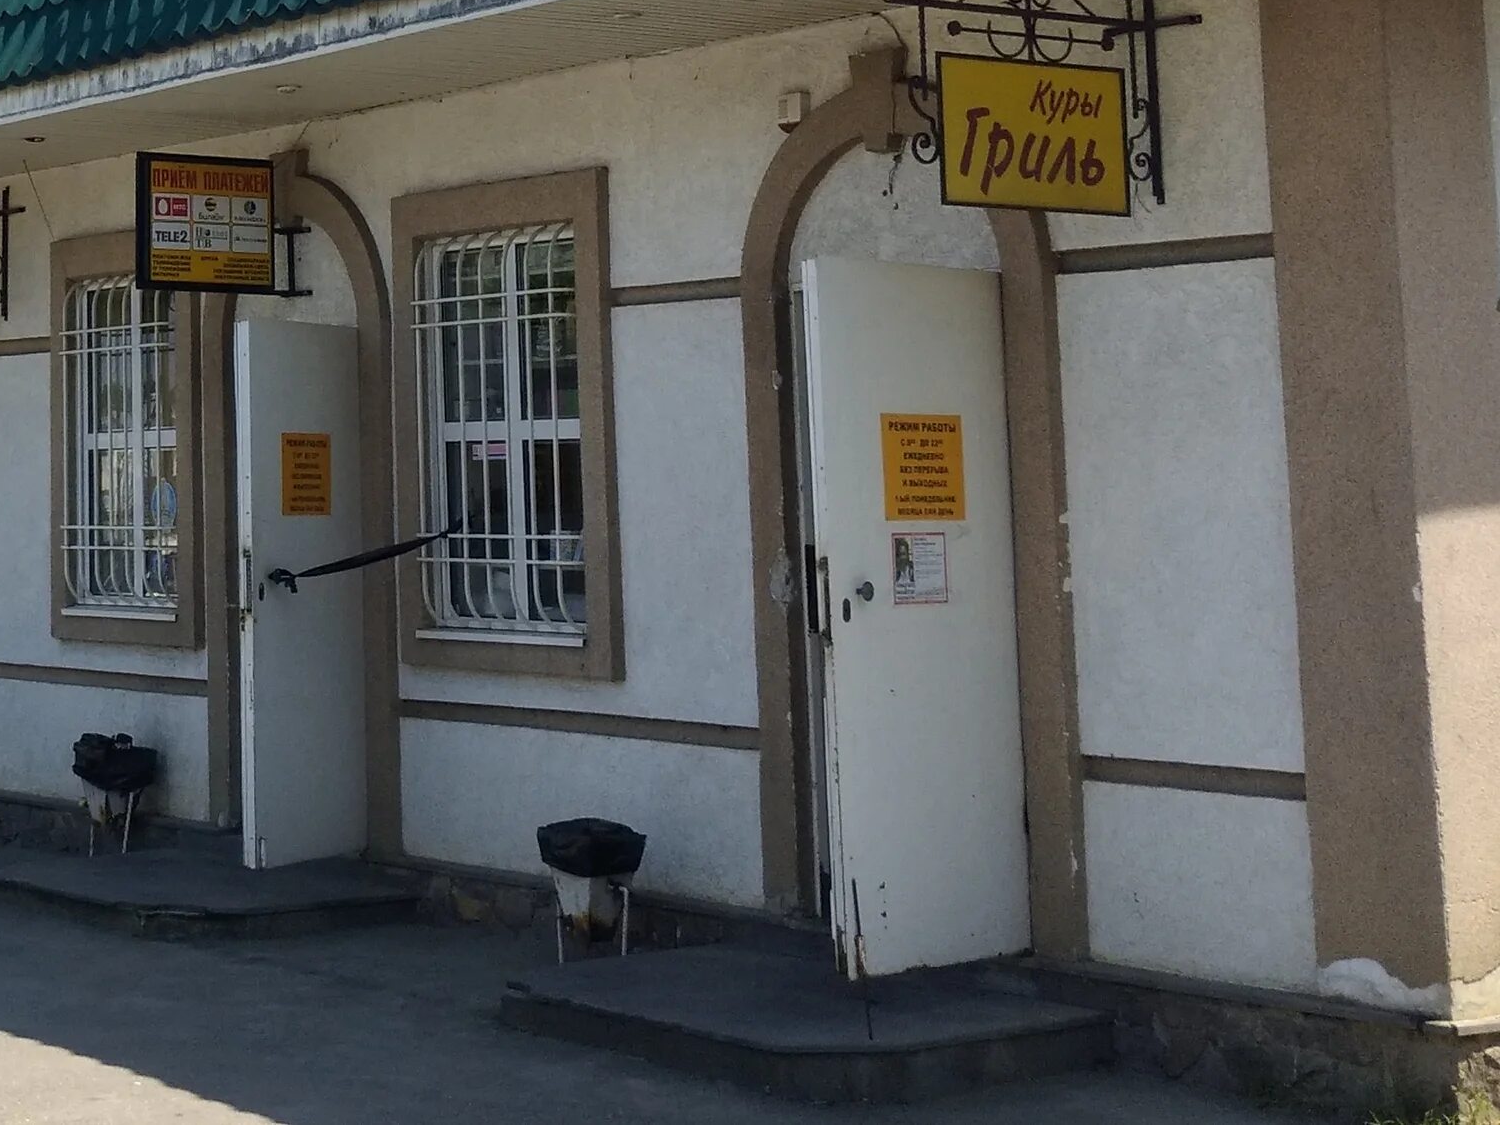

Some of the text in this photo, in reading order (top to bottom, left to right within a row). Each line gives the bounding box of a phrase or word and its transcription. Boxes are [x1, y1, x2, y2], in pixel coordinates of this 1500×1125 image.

[1029, 79, 1103, 124] Куры
[960, 107, 1105, 195] Гриль
[152, 165, 269, 194] ПРИЁМ ПЛАТЕЖЕЙ
[155, 230, 188, 243] TELE2
[921, 422, 956, 433] РАБОТЫ
